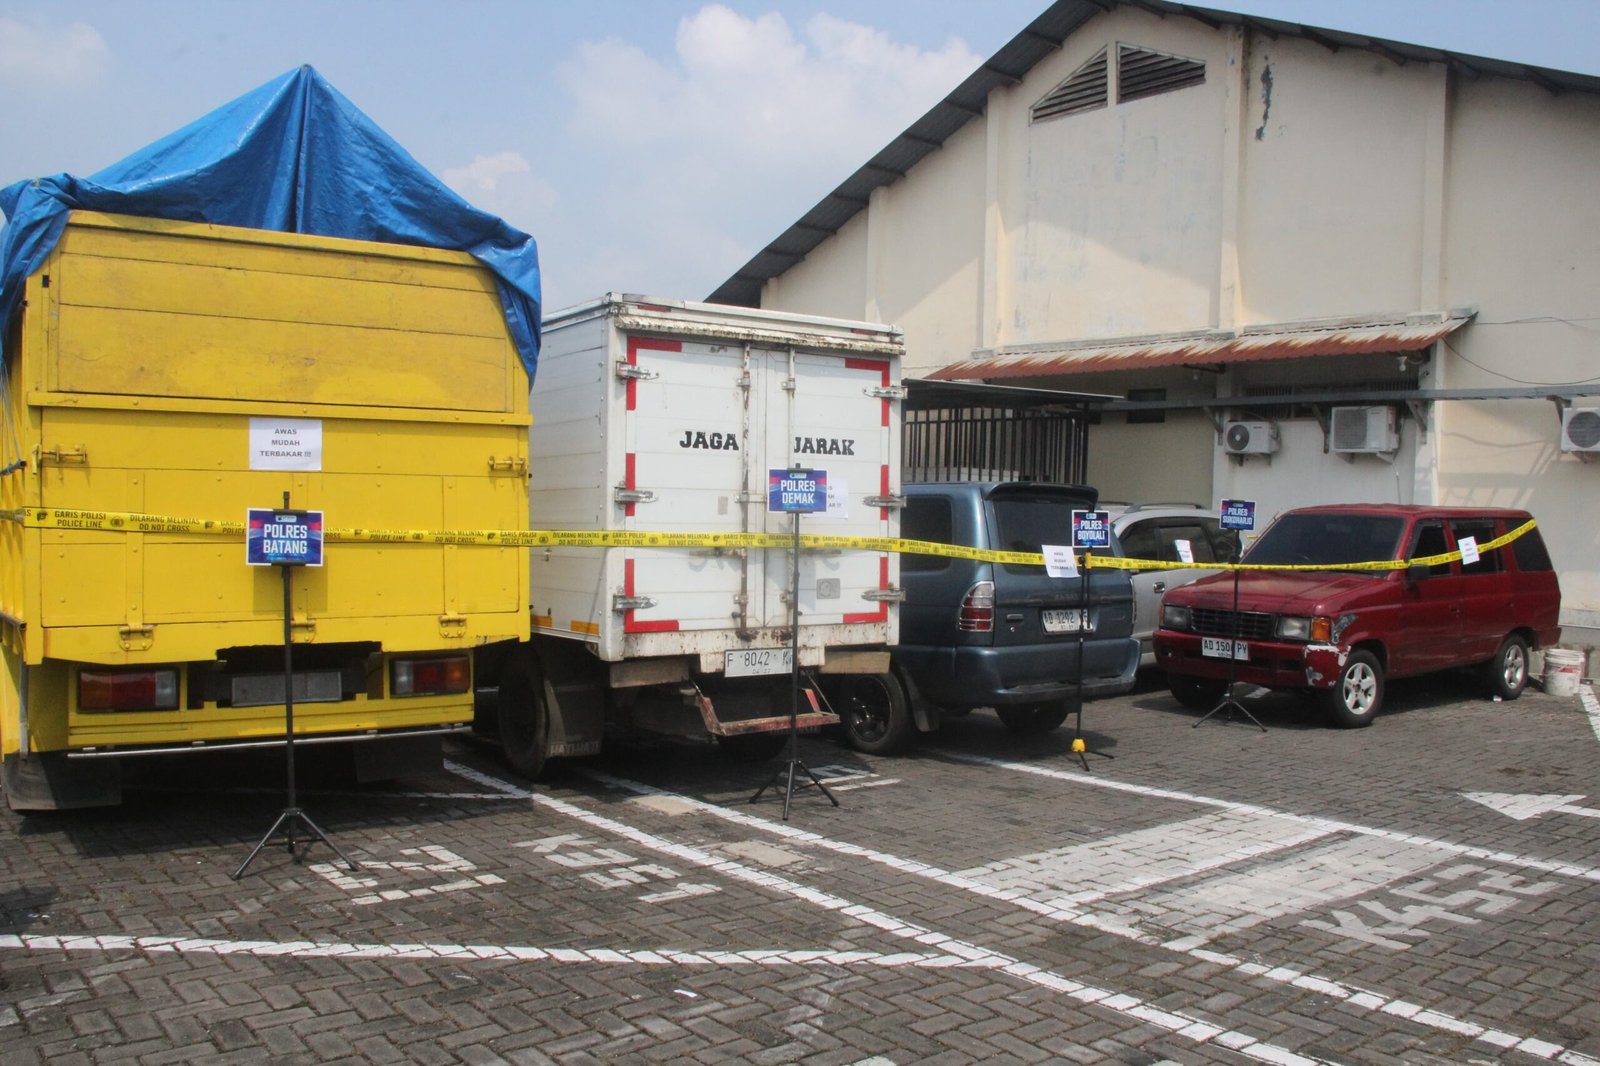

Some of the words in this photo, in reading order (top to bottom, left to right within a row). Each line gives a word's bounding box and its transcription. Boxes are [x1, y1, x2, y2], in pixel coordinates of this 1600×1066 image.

[680, 430, 739, 451] JAGA
[794, 436, 855, 456] JARAK
[780, 480, 815, 492] POLRES
[782, 492, 814, 504] DEMAK
[54, 510, 78, 518] GARIS
[80, 512, 106, 520] POLISI
[130, 514, 165, 523] DILARANG
[86, 520, 103, 528] LINE
[1080, 520, 1102, 530] POLRES
[264, 524, 308, 539] POLRES
[263, 540, 308, 554] BATANG
[1204, 640, 1213, 650] AD
[1216, 641, 1232, 652] 150
[728, 653, 733, 667] F
[744, 651, 770, 666] 8042
